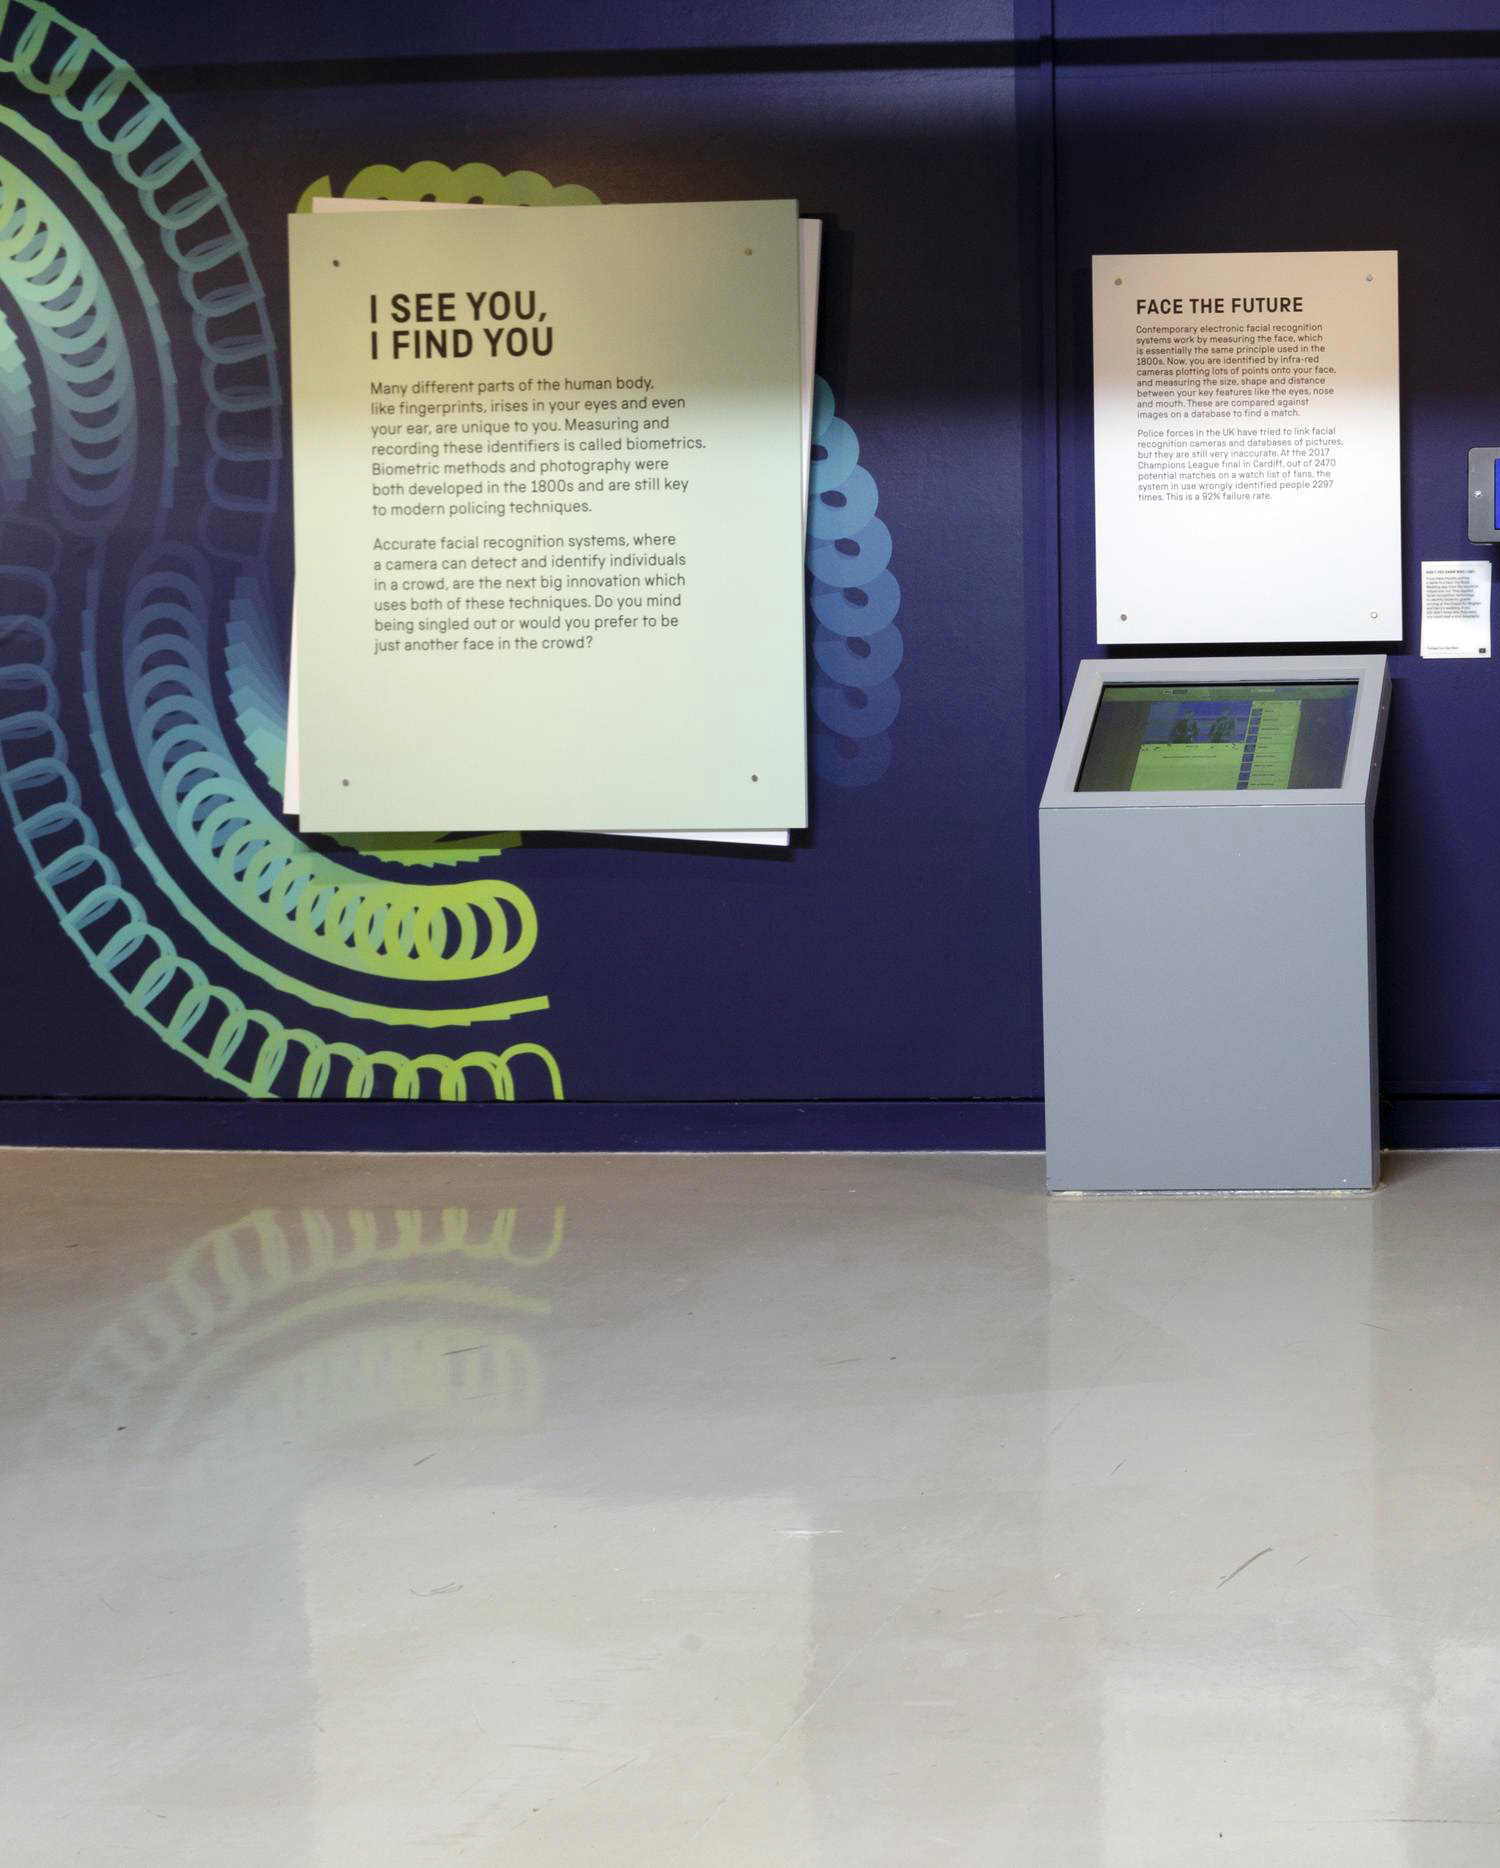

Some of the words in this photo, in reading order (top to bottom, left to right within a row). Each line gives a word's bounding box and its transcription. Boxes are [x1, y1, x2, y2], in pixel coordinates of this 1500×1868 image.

[370, 294, 377, 324] I
[391, 292, 456, 323] SEE
[466, 290, 546, 323] YOU,
[1137, 299, 1183, 315] FACE
[1189, 298, 1224, 314] THE
[1232, 297, 1303, 313] FUTURE
[1136, 324, 1198, 336] Contemporary
[1200, 324, 1244, 333] electronic
[1246, 323, 1270, 332] facial
[1272, 323, 1322, 334] recognition
[371, 331, 378, 360] I
[393, 329, 473, 359] FIND
[483, 326, 552, 358] YOU
[1136, 336, 1172, 346] systems
[1173, 336, 1194, 344] work
[1197, 335, 1208, 345] by
[1210, 334, 1255, 345] measuring
[1257, 334, 1272, 342] the
[1297, 334, 1323, 342] which
[1136, 347, 1144, 355] is
[1146, 346, 1192, 357] essentially
[1194, 346, 1208, 354] the
[1236, 345, 1275, 356] principle
[1277, 344, 1298, 353] used
[1301, 344, 1308, 352] in
[1311, 344, 1325, 352] the
[1189, 358, 1205, 368] you
[1223, 356, 1266, 364] identified
[1268, 356, 1278, 366] by
[1280, 355, 1319, 364] infra-red
[1176, 365, 1210, 378] plotting
[1211, 367, 1228, 375] lots
[1230, 367, 1240, 375] of
[1242, 366, 1269, 376] points
[1270, 367, 1291, 375] onto
[1292, 367, 1313, 376] your
[370, 381, 408, 398] Many
[412, 380, 474, 394] different
[478, 380, 514, 396] parts
[518, 378, 534, 391] of
[536, 378, 560, 391] the
[564, 377, 612, 390] human
[616, 376, 654, 392] body,
[1137, 379, 1153, 387] and
[1155, 378, 1201, 389] measuring
[1202, 378, 1218, 386] the
[1241, 377, 1268, 389] shape
[1270, 377, 1286, 385] and
[1287, 375, 1325, 385] distance
[1137, 389, 1175, 398] between
[1176, 390, 1196, 400] your
[1198, 389, 1214, 398] key
[1216, 388, 1252, 396] features
[1254, 386, 1270, 396] like
[1272, 387, 1286, 396] the
[371, 402, 395, 415] like
[399, 400, 487, 418] fingerprints,
[491, 402, 528, 412] irises
[532, 402, 544, 411] in
[548, 401, 580, 414] your
[584, 400, 617, 414] eyes
[621, 396, 647, 410] and
[652, 398, 685, 409] even
[1137, 400, 1153, 408] and
[1186, 398, 1213, 408] These
[1231, 398, 1275, 409] compared
[1277, 397, 1309, 408] against
[1137, 410, 1168, 421] images
[1191, 409, 1231, 418] database
[1233, 410, 1242, 418] to
[1243, 409, 1262, 417] find
[371, 425, 402, 438] your
[406, 424, 432, 435] ear,
[436, 424, 458, 434] are
[462, 423, 510, 436] unique
[514, 421, 528, 432] to
[532, 422, 561, 435] you.
[565, 417, 639, 435] Measuring
[643, 416, 669, 430] and
[372, 441, 439, 459] recording
[443, 441, 483, 454] these
[487, 439, 560, 453] identifiers
[564, 442, 575, 452] is
[579, 438, 622, 451] called
[626, 436, 706, 450] biometrics.
[1138, 439, 1187, 450] recognition
[1229, 439, 1244, 447] and
[1247, 438, 1292, 447] databases
[1294, 437, 1303, 446] of
[1138, 451, 1152, 459] but
[1154, 450, 1174, 460] they
[1192, 450, 1207, 458] still
[1210, 451, 1228, 459] very
[1309, 448, 1330, 456] 2017
[372, 461, 440, 476] Biometric
[444, 460, 506, 474] methods
[510, 460, 536, 473] and
[540, 457, 631, 476] photography
[635, 460, 669, 471] were
[372, 483, 404, 496] both
[408, 481, 482, 498] developed
[487, 483, 499, 493] in
[504, 480, 527, 493] the
[531, 479, 574, 493] 1800s
[578, 478, 604, 492] and
[608, 481, 630, 491] are
[635, 478, 660, 491] still
[664, 477, 688, 493] key
[372, 504, 387, 516] to
[391, 502, 445, 516] modern
[449, 501, 506, 518] policing
[509, 499, 592, 517] techniques.
